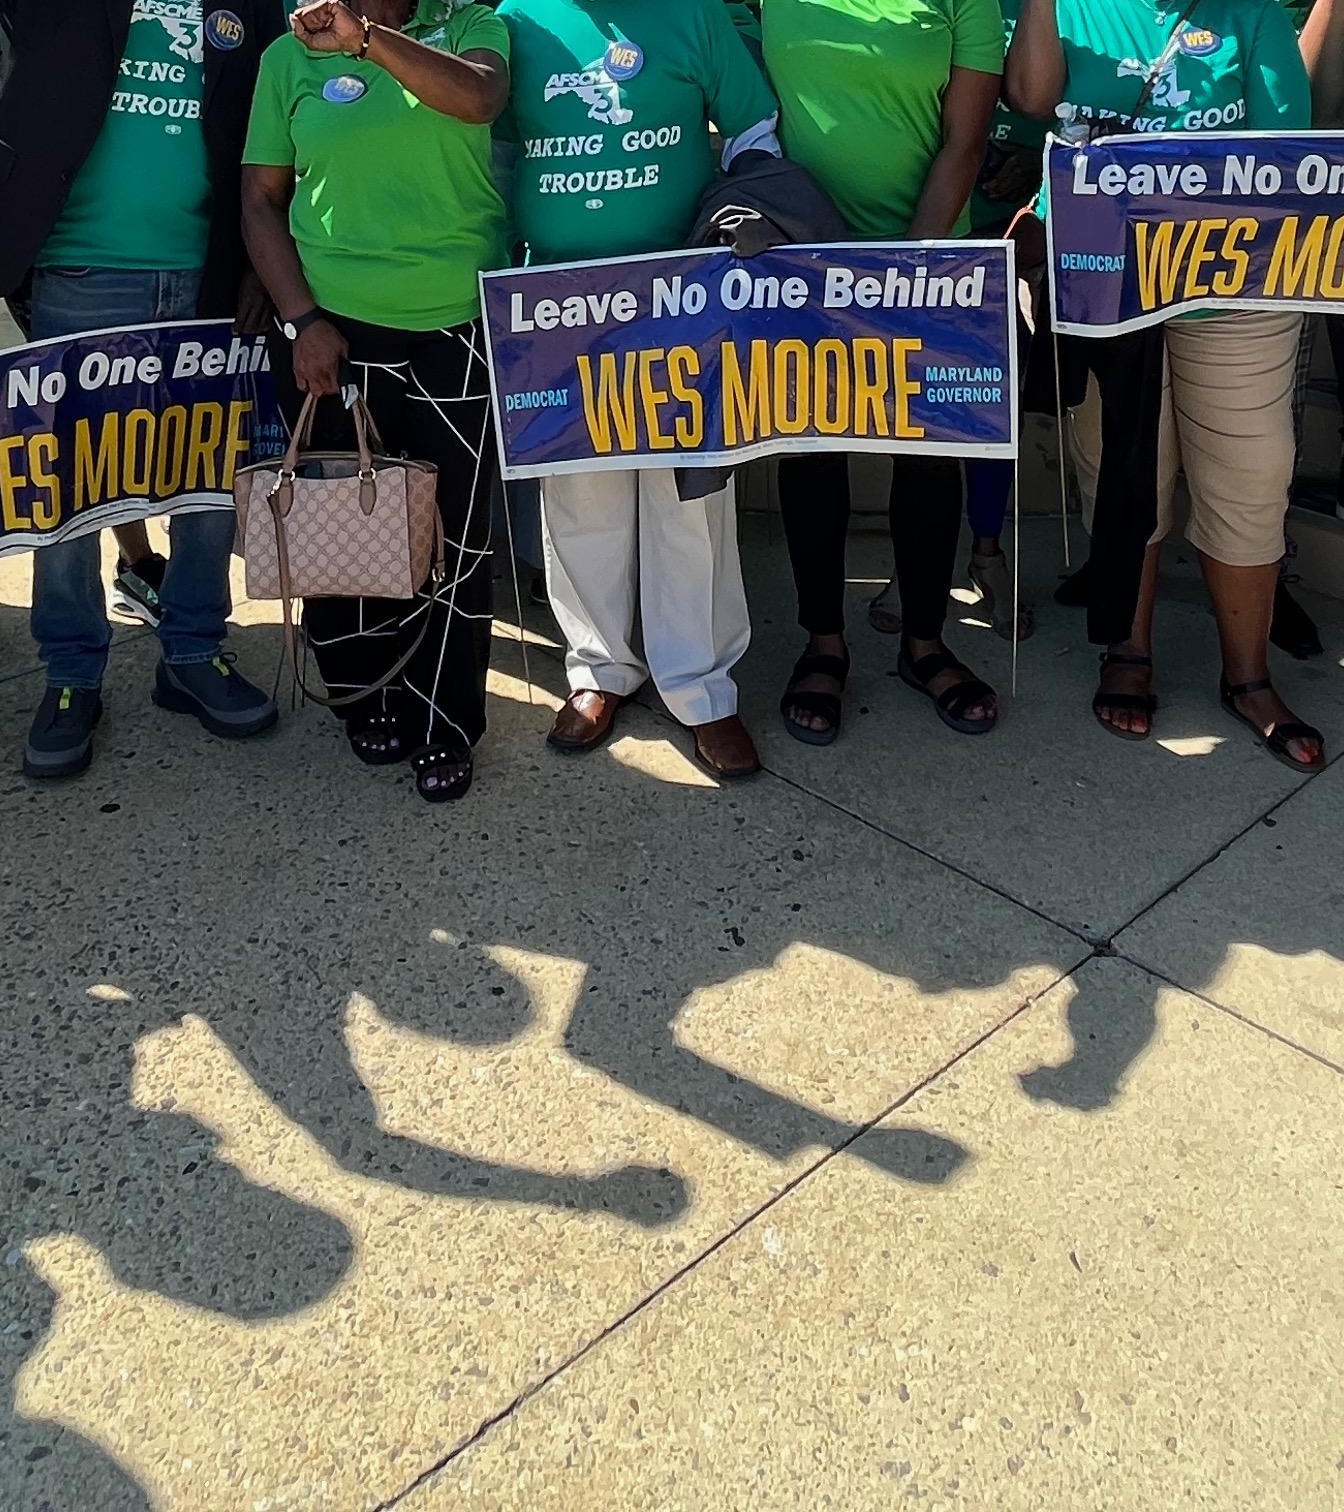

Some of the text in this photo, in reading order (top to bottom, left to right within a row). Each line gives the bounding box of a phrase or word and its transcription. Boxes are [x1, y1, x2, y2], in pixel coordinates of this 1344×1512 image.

[216, 16, 242, 41] WES
[1183, 31, 1214, 47] WES
[609, 46, 638, 68] WES
[119, 58, 186, 83] KING
[545, 70, 614, 88] AFSCM
[112, 91, 203, 119] TROUB
[622, 126, 681, 152] GOOD
[539, 164, 659, 194] TROUBLE
[1072, 155, 1207, 197] Leave
[1221, 154, 1281, 196] No
[1061, 252, 1126, 273] DEMOCRAT
[1135, 216, 1261, 312] WES
[510, 265, 986, 333] Leave No One Behind
[7, 364, 66, 411] No
[78, 350, 161, 391] One
[173, 333, 270, 379] Behi
[926, 365, 1003, 383] MARYLAND
[505, 389, 568, 412] DEMOCRAT
[576, 337, 926, 454] WES MOORE
[926, 386, 1003, 404] GOVERNOR
[73, 400, 253, 514] MOORE
